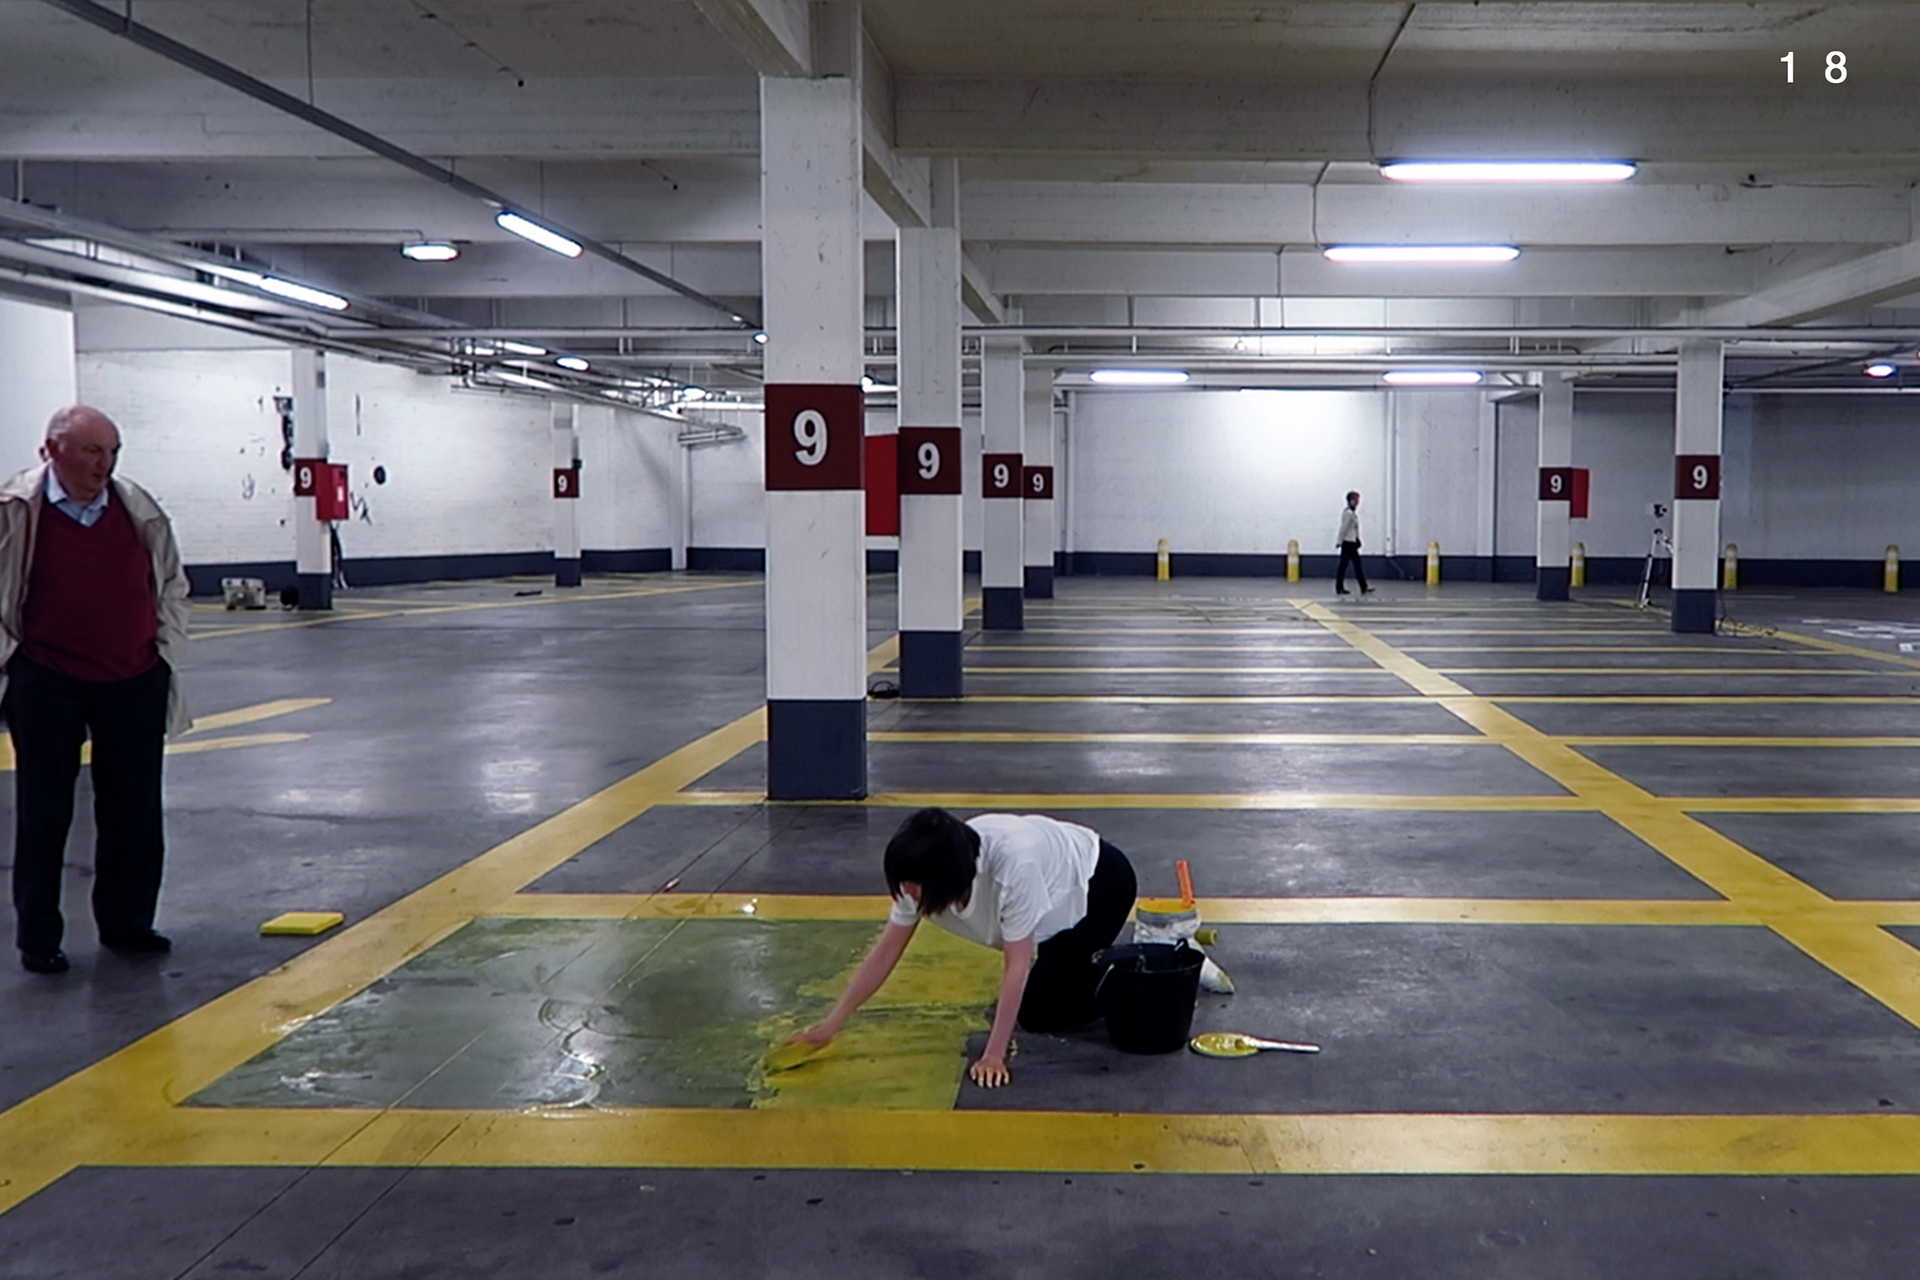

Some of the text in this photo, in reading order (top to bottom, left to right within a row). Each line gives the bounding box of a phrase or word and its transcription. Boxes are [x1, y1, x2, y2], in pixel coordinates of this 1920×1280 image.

[793, 409, 828, 466] 9
[917, 442, 940, 480] 9
[299, 466, 312, 489] 9
[557, 474, 568, 493] 9
[993, 463, 1009, 488] 9
[1032, 473, 1044, 493] 9
[1550, 474, 1562, 494] 9
[1692, 465, 1708, 490] 9
